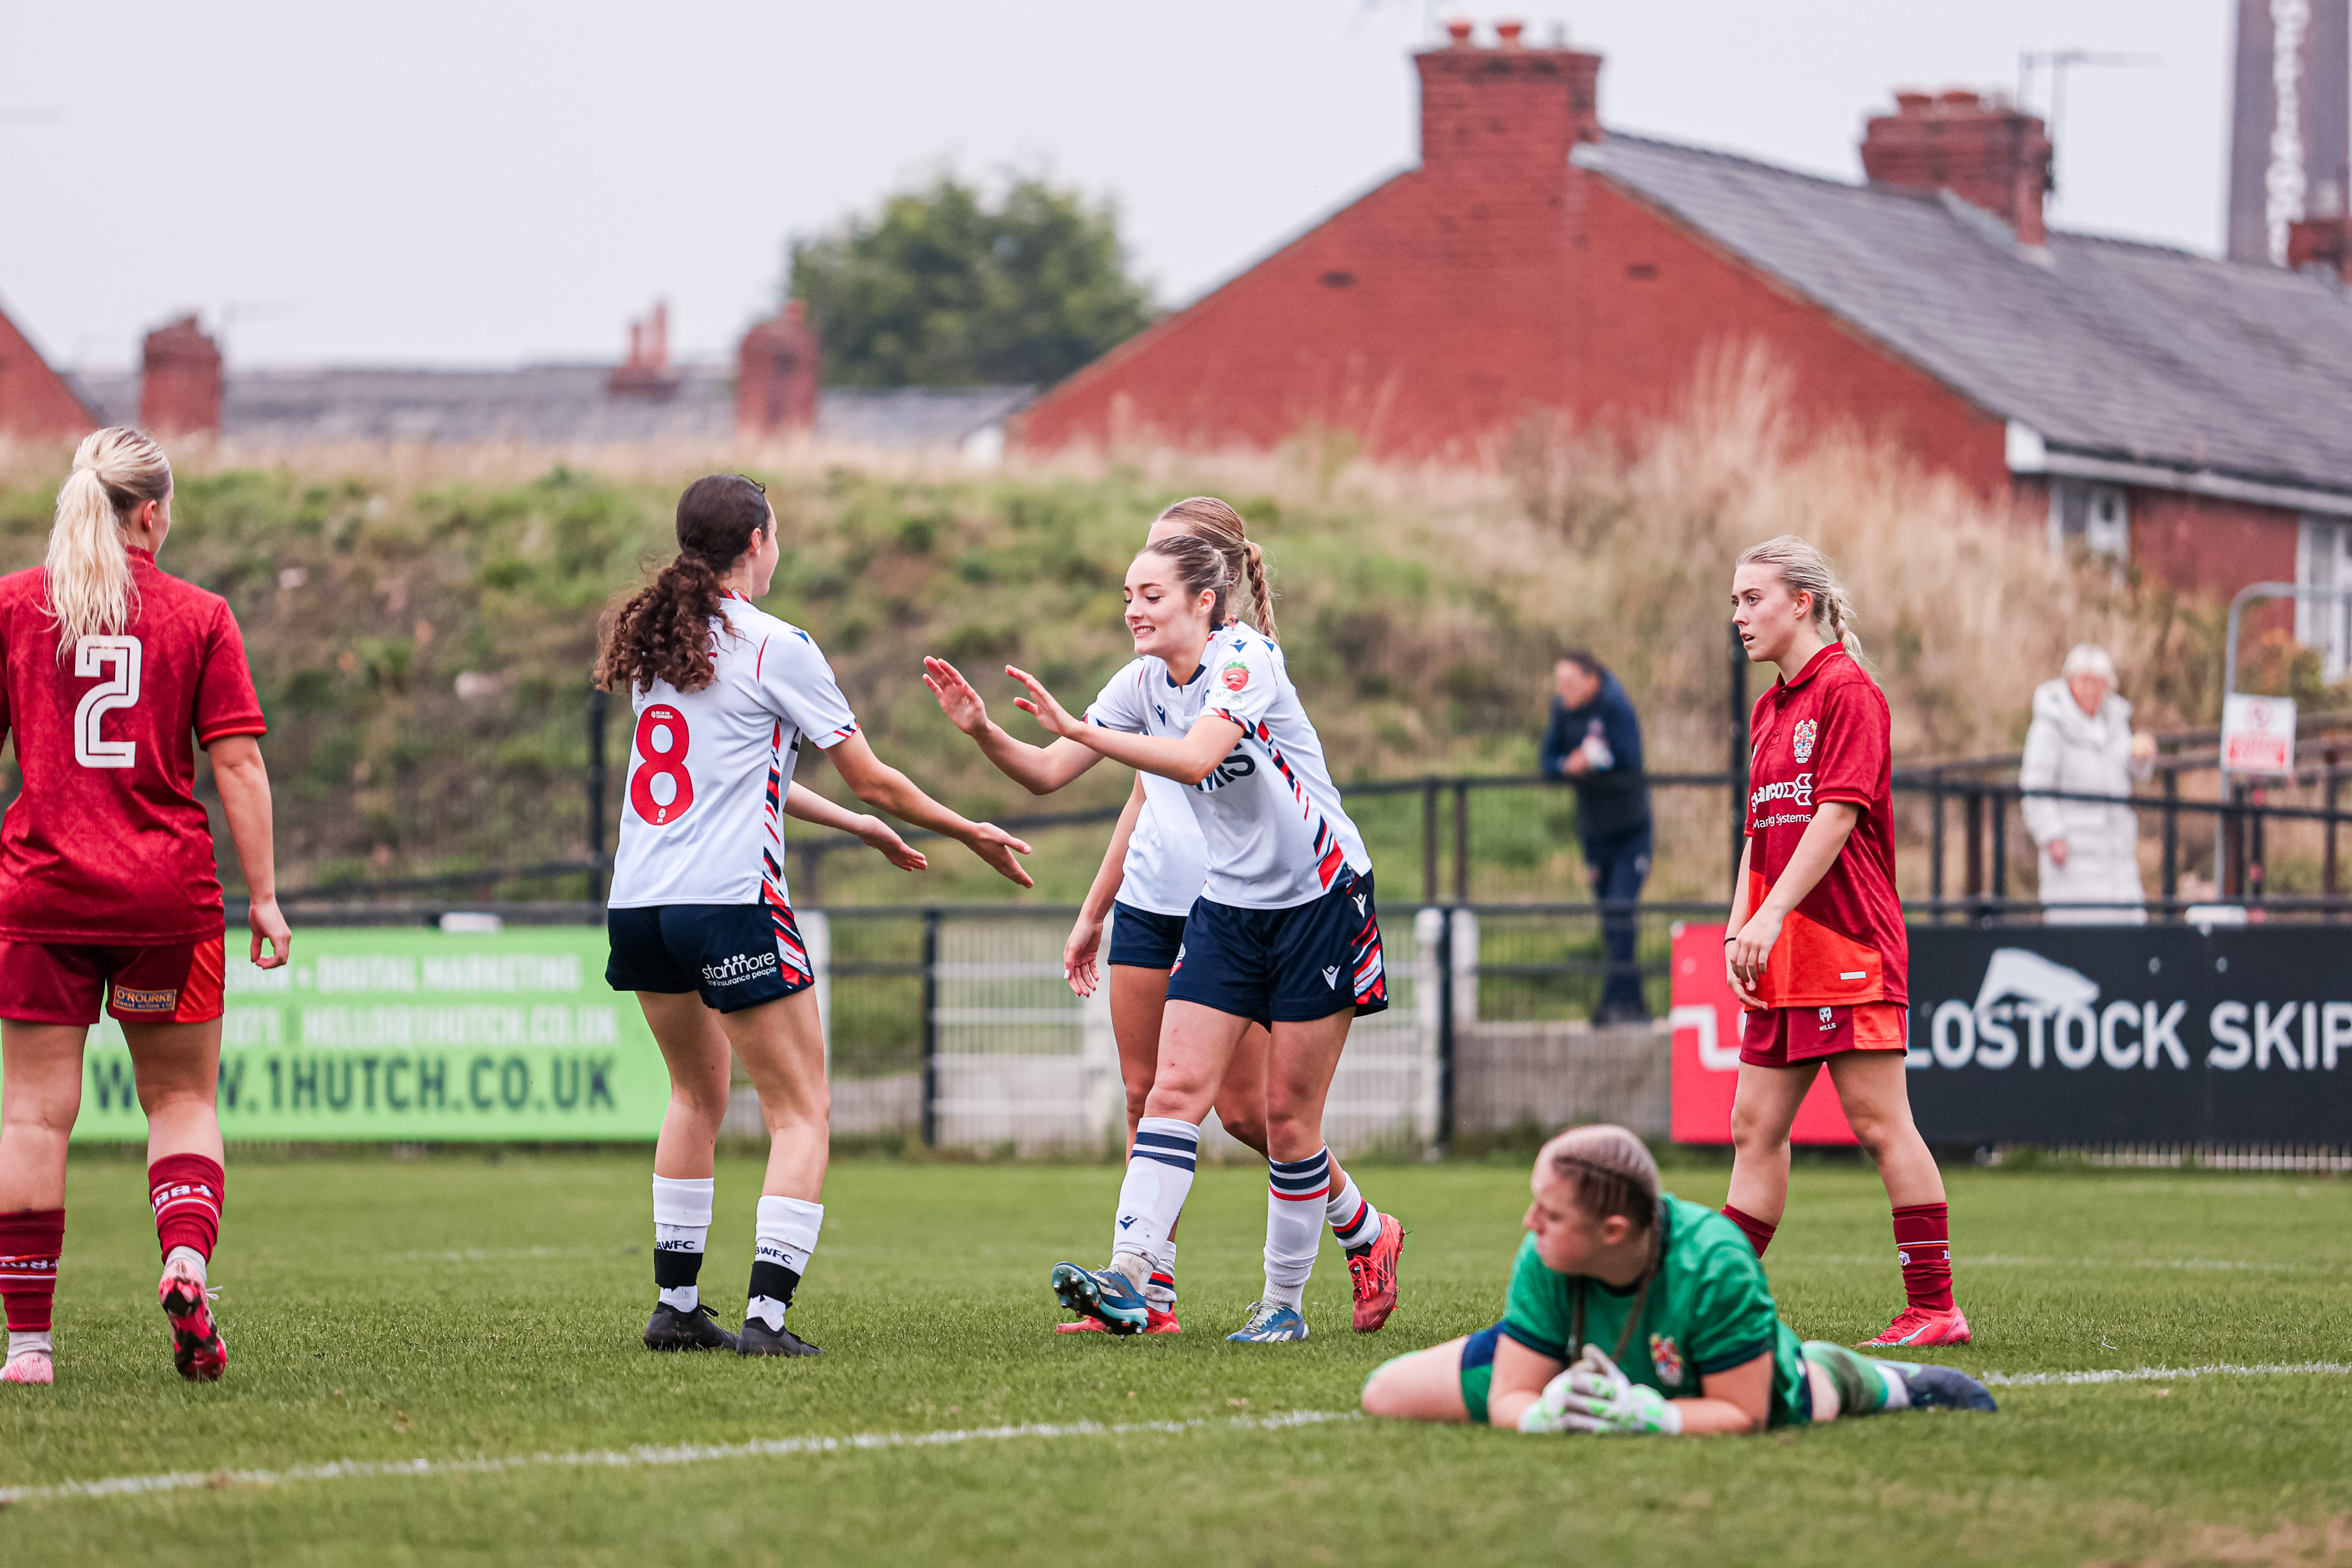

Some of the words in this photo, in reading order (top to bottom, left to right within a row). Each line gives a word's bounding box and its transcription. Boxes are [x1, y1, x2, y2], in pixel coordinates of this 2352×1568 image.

[75, 635, 142, 768] 2
[631, 704, 693, 826] 8
[1776, 813, 1811, 826] Systems
[702, 953, 776, 979] stanmore
[716, 974, 751, 986] insurance
[751, 966, 777, 979] people
[117, 990, 172, 1003] O'ROURKE
[1819, 1022, 1836, 1031] MILLS
[1905, 999, 2190, 1070] LOSTOCK
[2208, 1000, 2352, 1070] SKIP
